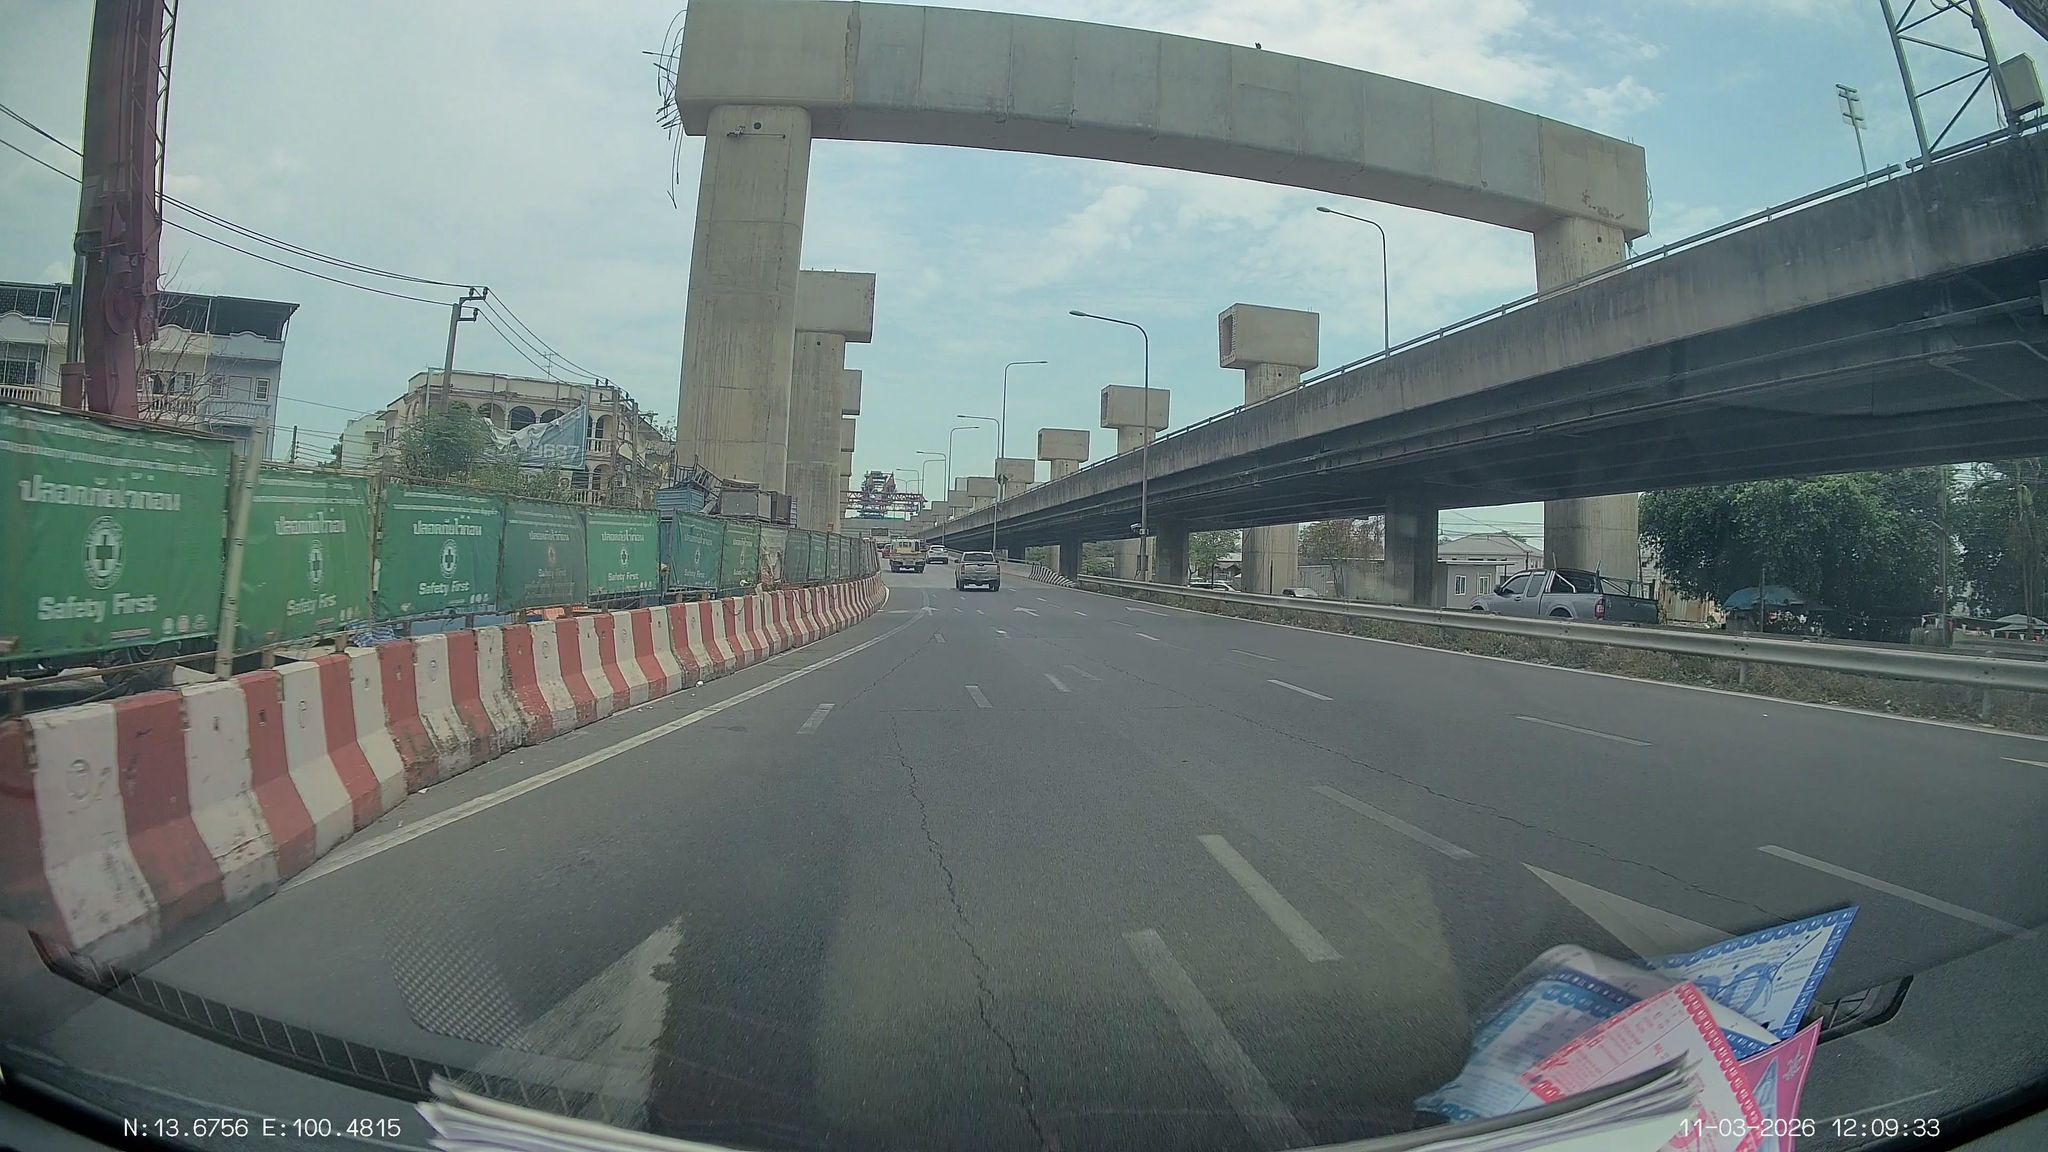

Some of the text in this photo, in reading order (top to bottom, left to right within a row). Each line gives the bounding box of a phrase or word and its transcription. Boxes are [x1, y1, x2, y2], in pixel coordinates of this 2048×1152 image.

[418, 580, 470, 596] Safety First
[37, 592, 158, 623] Safety First
